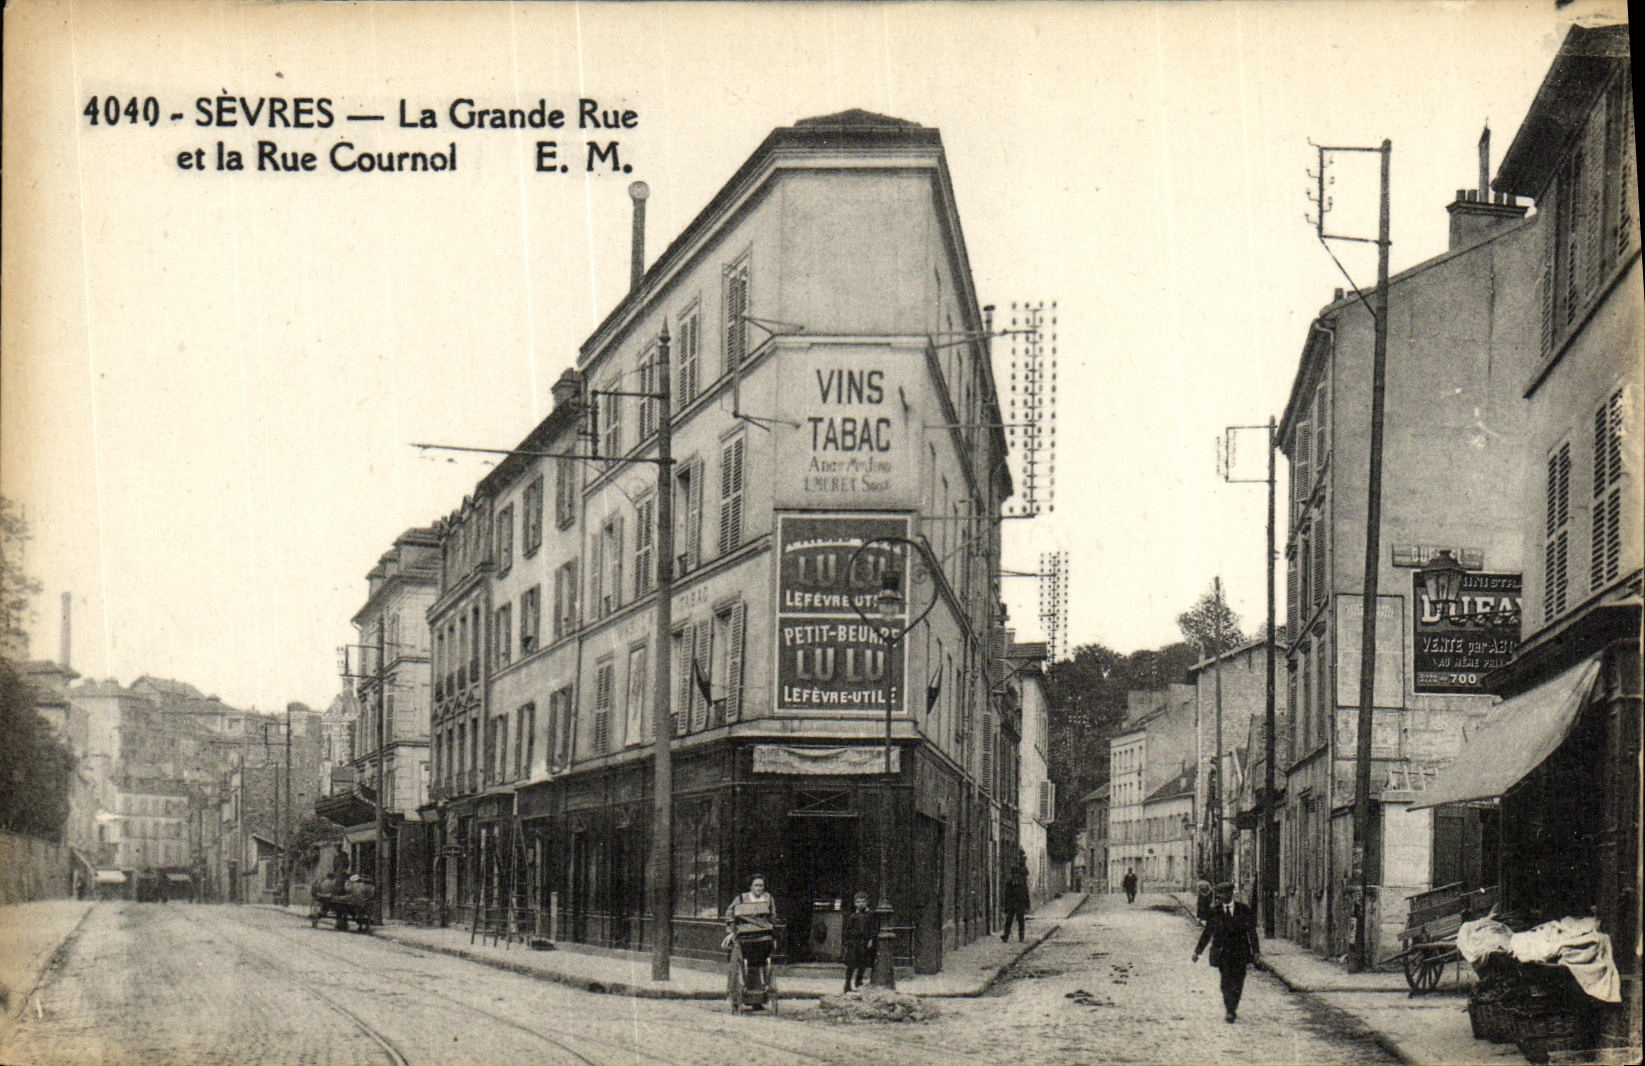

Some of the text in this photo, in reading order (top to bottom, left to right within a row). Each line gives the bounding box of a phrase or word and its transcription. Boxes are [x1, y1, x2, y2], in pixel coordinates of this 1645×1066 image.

[816, 369, 884, 404] VINS
[807, 416, 891, 452] TABAC
[799, 554, 837, 585] LU
[784, 624, 901, 648] PETIT-BEURRE
[1423, 637, 1463, 653] VENTE
[796, 647, 885, 681] LU LU
[1449, 673, 1477, 684] 700
